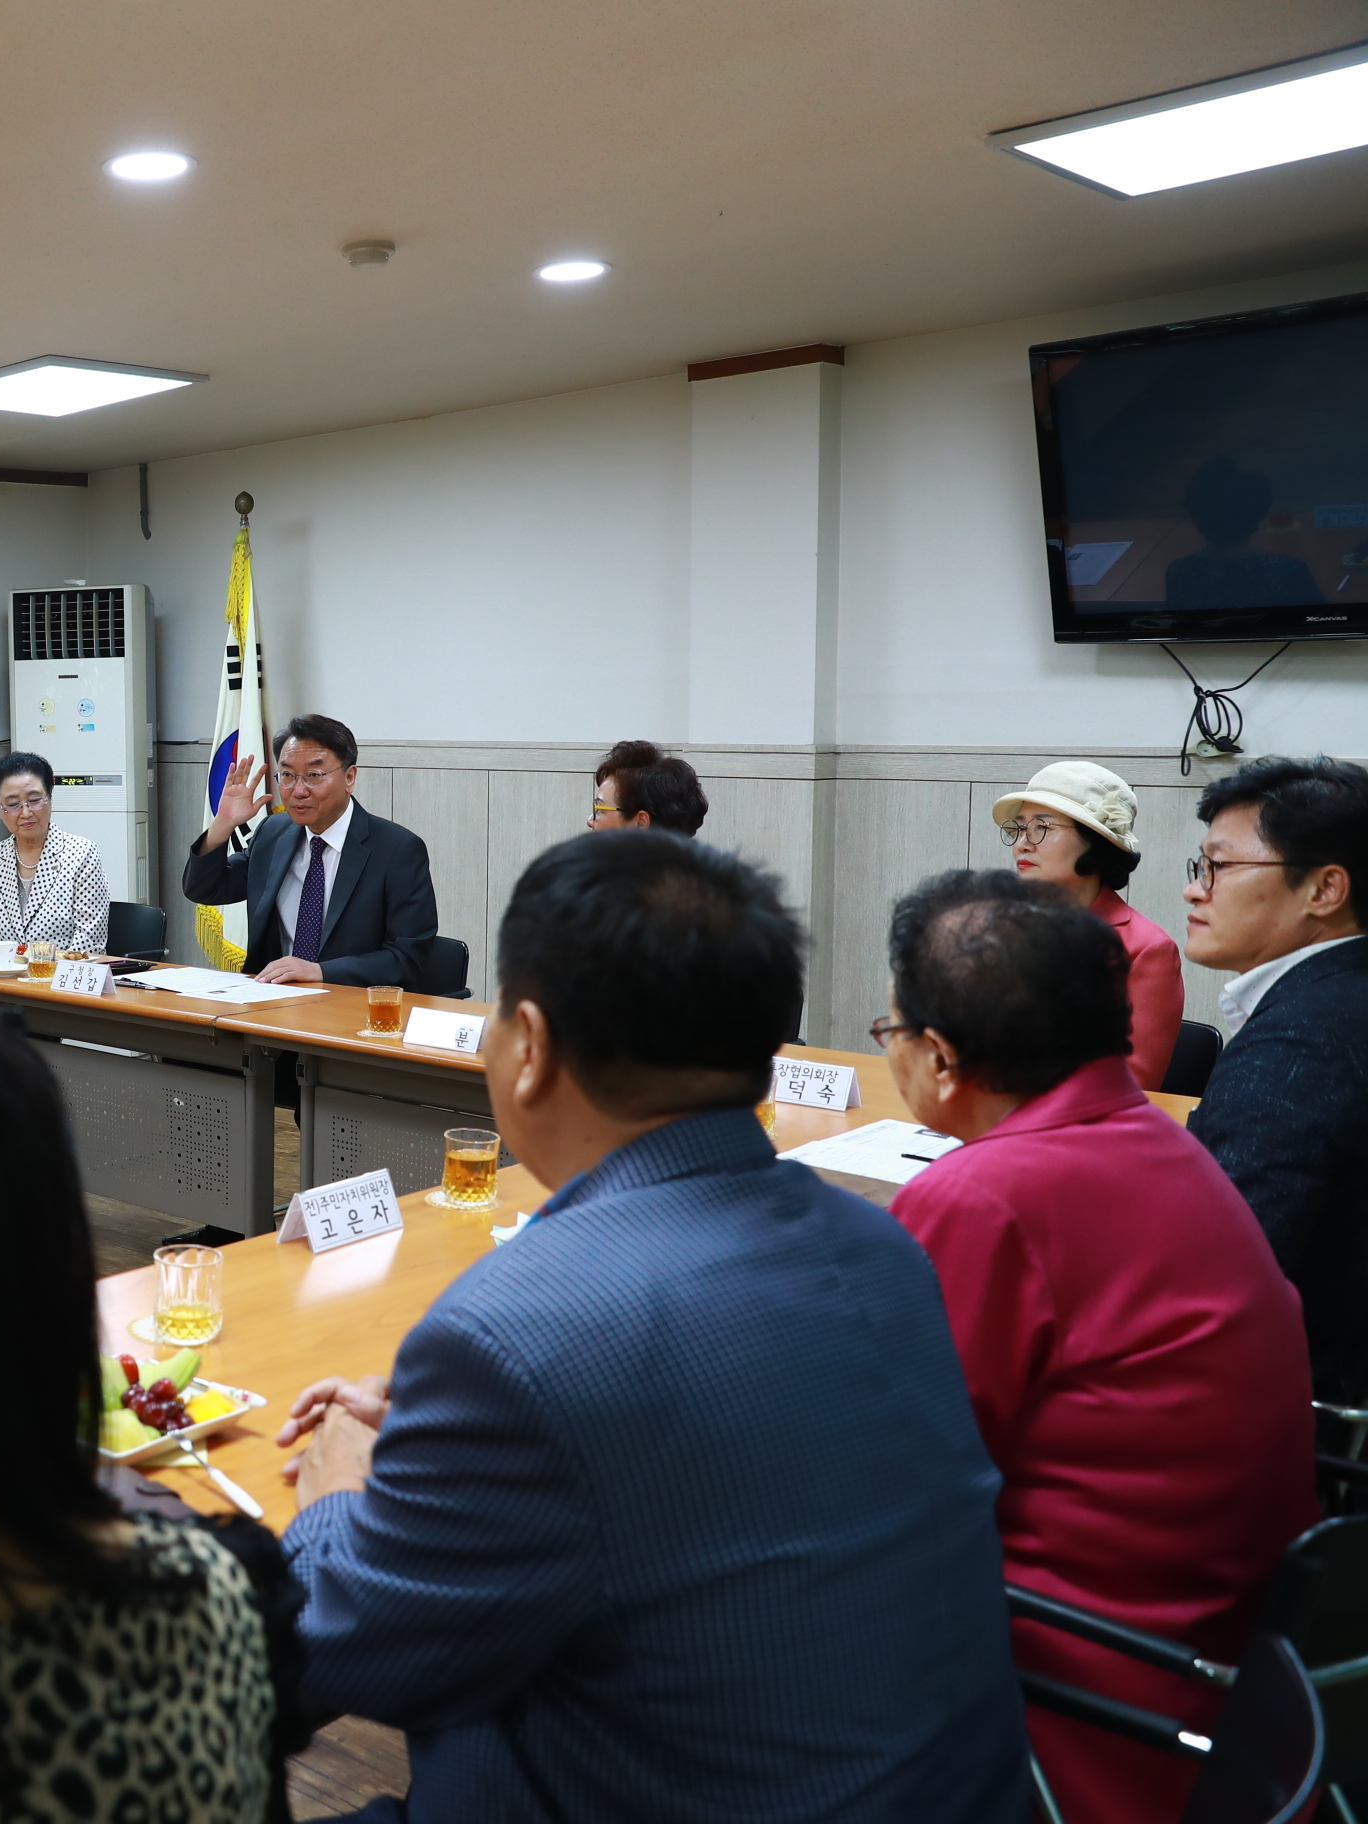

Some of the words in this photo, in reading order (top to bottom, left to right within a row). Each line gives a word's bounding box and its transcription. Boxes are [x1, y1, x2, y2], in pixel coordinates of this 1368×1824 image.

[59, 974, 98, 992] 김선갑
[68, 964, 95, 977] 구청장
[304, 1178, 390, 1217] 전)주민자치위원장
[320, 1199, 389, 1240] 고은자
